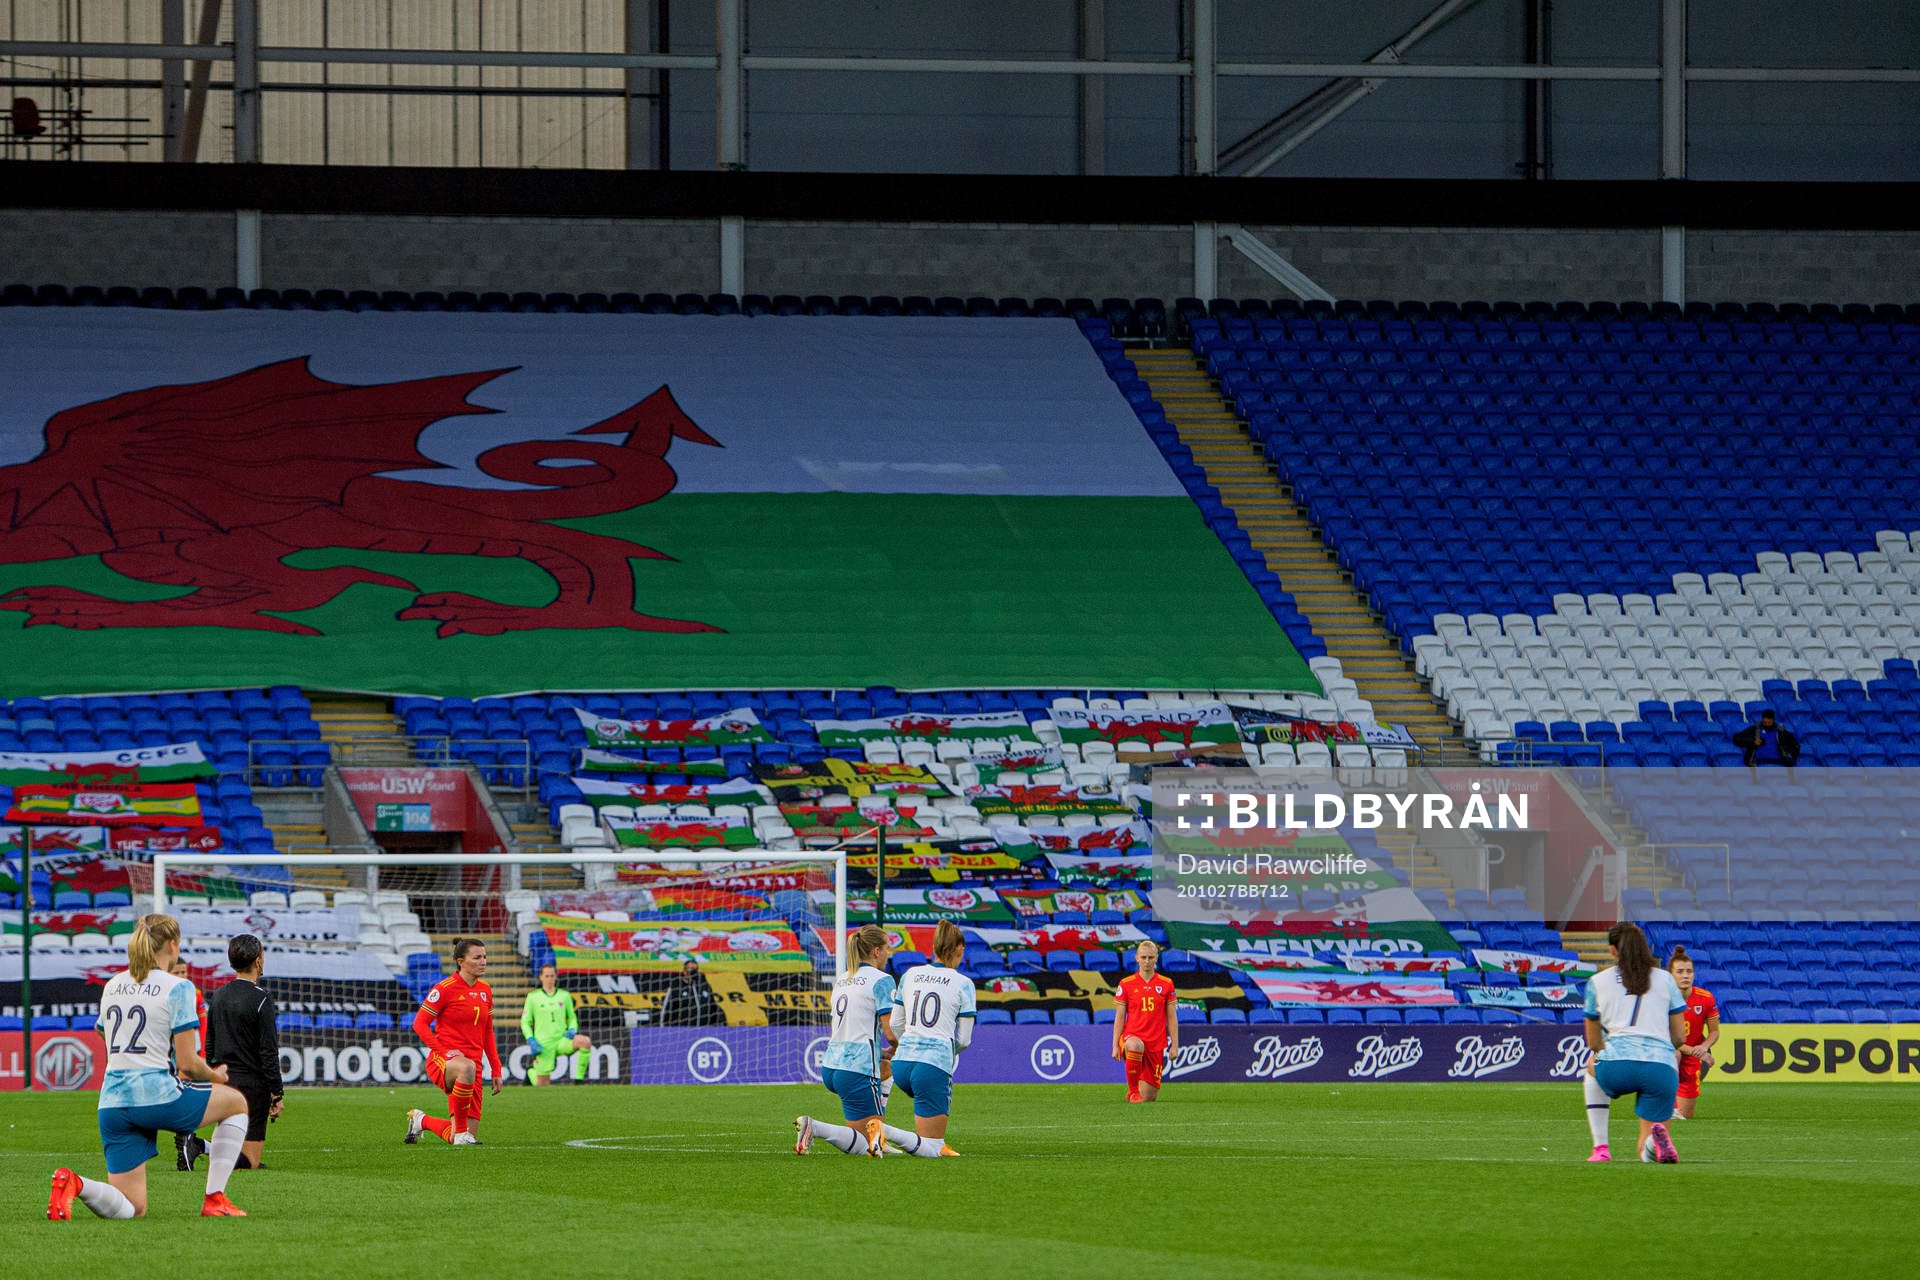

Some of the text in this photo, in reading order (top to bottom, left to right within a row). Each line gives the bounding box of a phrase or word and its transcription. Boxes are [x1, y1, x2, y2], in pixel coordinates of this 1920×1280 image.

[116, 746, 189, 763] CCFC
[381, 777, 426, 794] USW
[1512, 782, 1539, 792] Stand
[909, 855, 940, 866] ON
[951, 854, 997, 866] SEA
[914, 974, 951, 987] GRAHAM
[836, 993, 849, 1028] 9
[910, 989, 942, 1028] 10
[1140, 996, 1155, 1012] 15
[473, 1006, 481, 1026] 7
[106, 1004, 148, 1054] 22
[41, 1042, 88, 1087] MG
[697, 1052, 722, 1069] BT
[1041, 1048, 1065, 1066] BT
[1246, 1035, 1324, 1079] Boots
[1348, 1035, 1427, 1079] Boots
[1448, 1035, 1526, 1079] Boots
